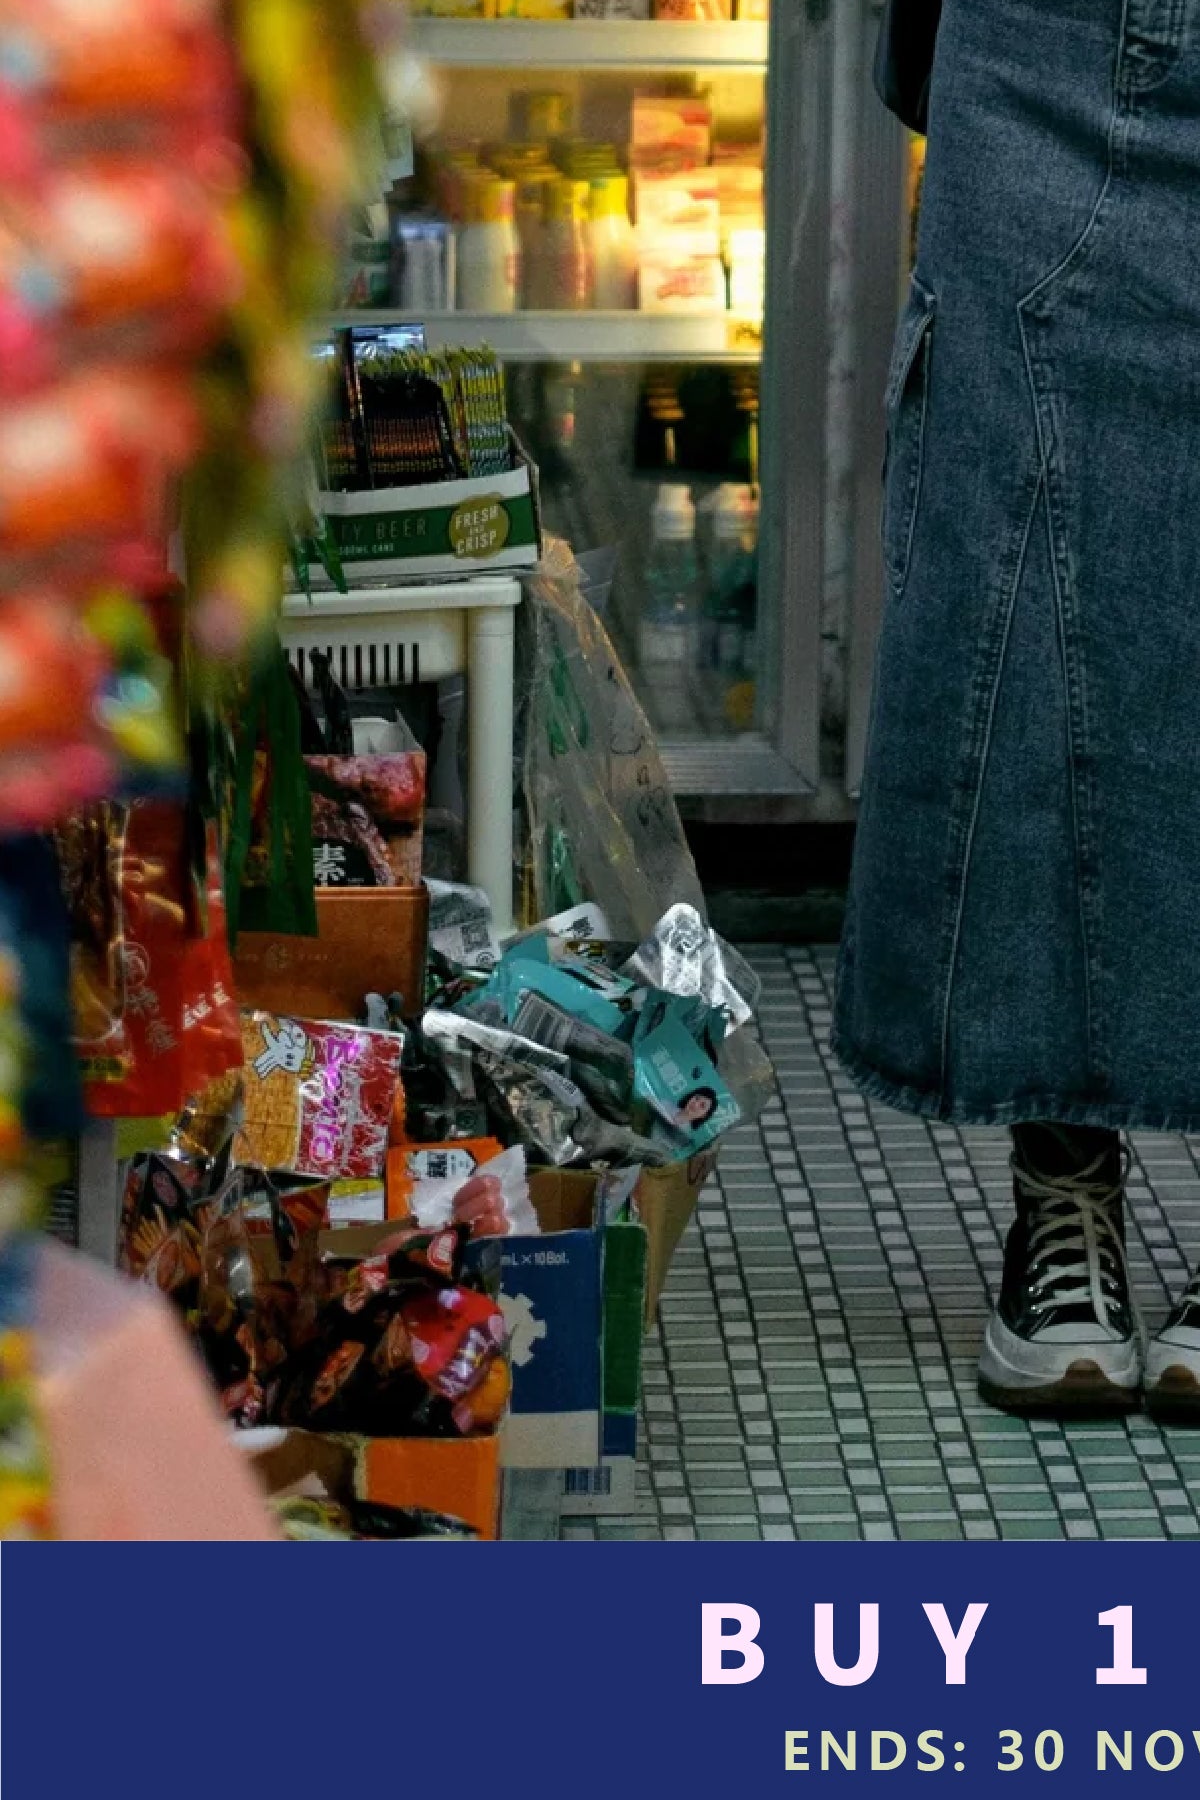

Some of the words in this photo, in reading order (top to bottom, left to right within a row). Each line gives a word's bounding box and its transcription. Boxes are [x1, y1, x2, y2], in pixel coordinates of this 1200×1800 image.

[455, 505, 499, 529] FRESH
[375, 518, 426, 541] BEER
[457, 529, 497, 555] CRISP
